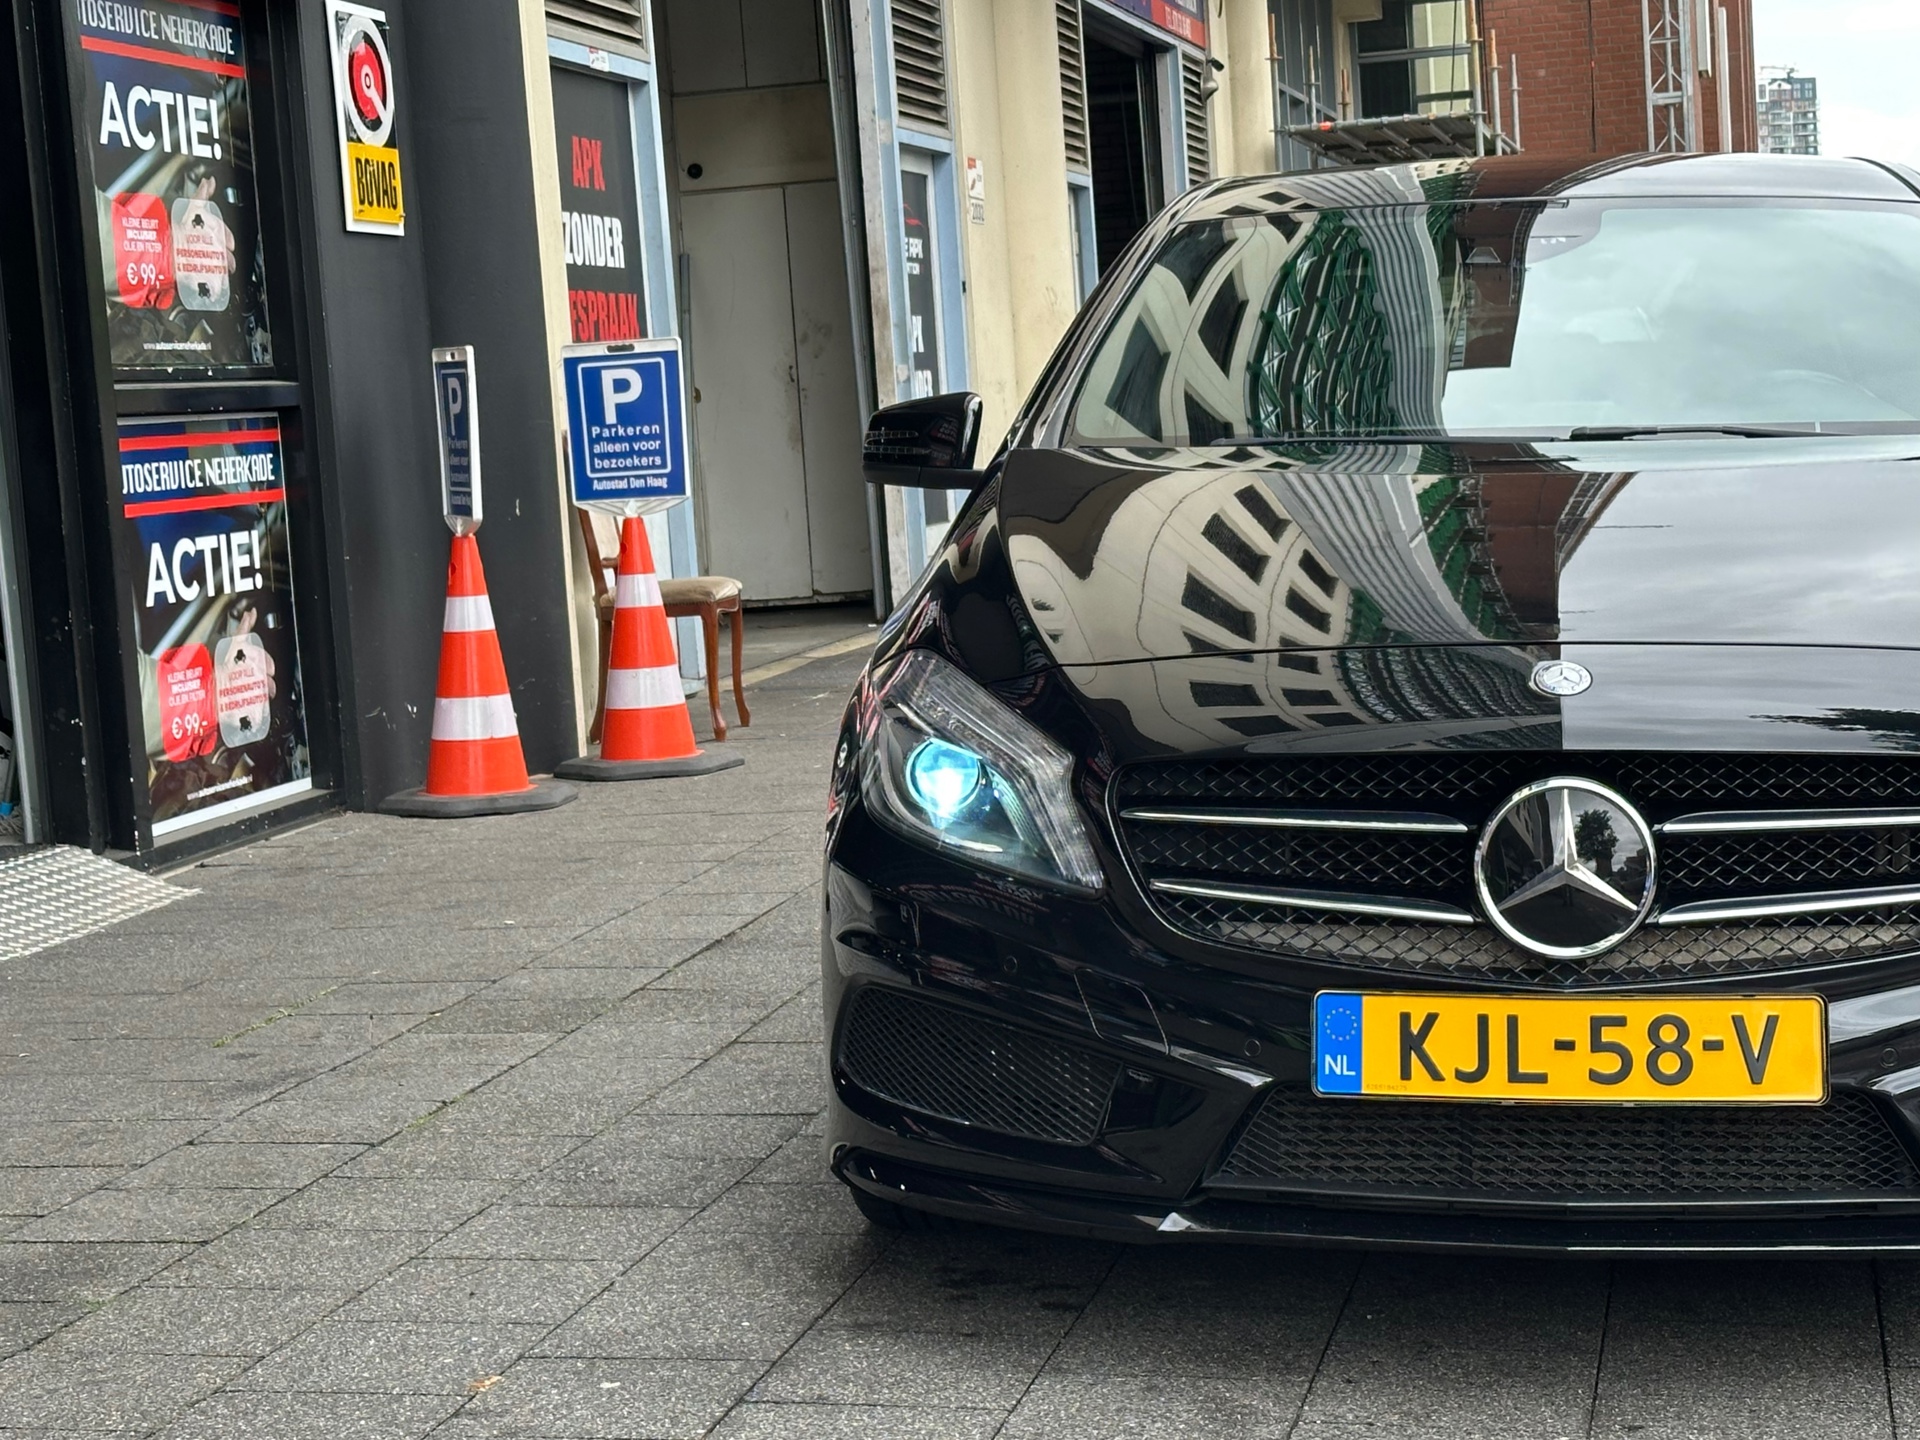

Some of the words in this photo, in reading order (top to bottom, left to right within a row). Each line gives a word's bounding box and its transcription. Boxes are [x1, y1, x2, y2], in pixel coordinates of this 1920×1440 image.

[77, 0, 159, 40] TOSERVICE
[160, 13, 235, 55] NEHERKADE
[100, 81, 223, 160] ACTIE!
[355, 156, 398, 211] BOVAG
[572, 135, 605, 191] APK
[562, 211, 625, 269] ZONDER
[447, 377, 462, 436] P
[601, 368, 643, 425] P
[591, 424, 660, 439] Parkeren
[593, 441, 630, 454] alleen
[632, 440, 661, 452] voor
[204, 453, 275, 487] NEHERKADE
[593, 478, 628, 491] Autostad
[629, 478, 646, 489] Den
[647, 476, 668, 489] Haag
[594, 455, 662, 469] bezoekers
[145, 530, 263, 609] ACTIE!
[1324, 1053, 1356, 1077] NL
[1398, 1011, 1780, 1086] KJL-58-V
